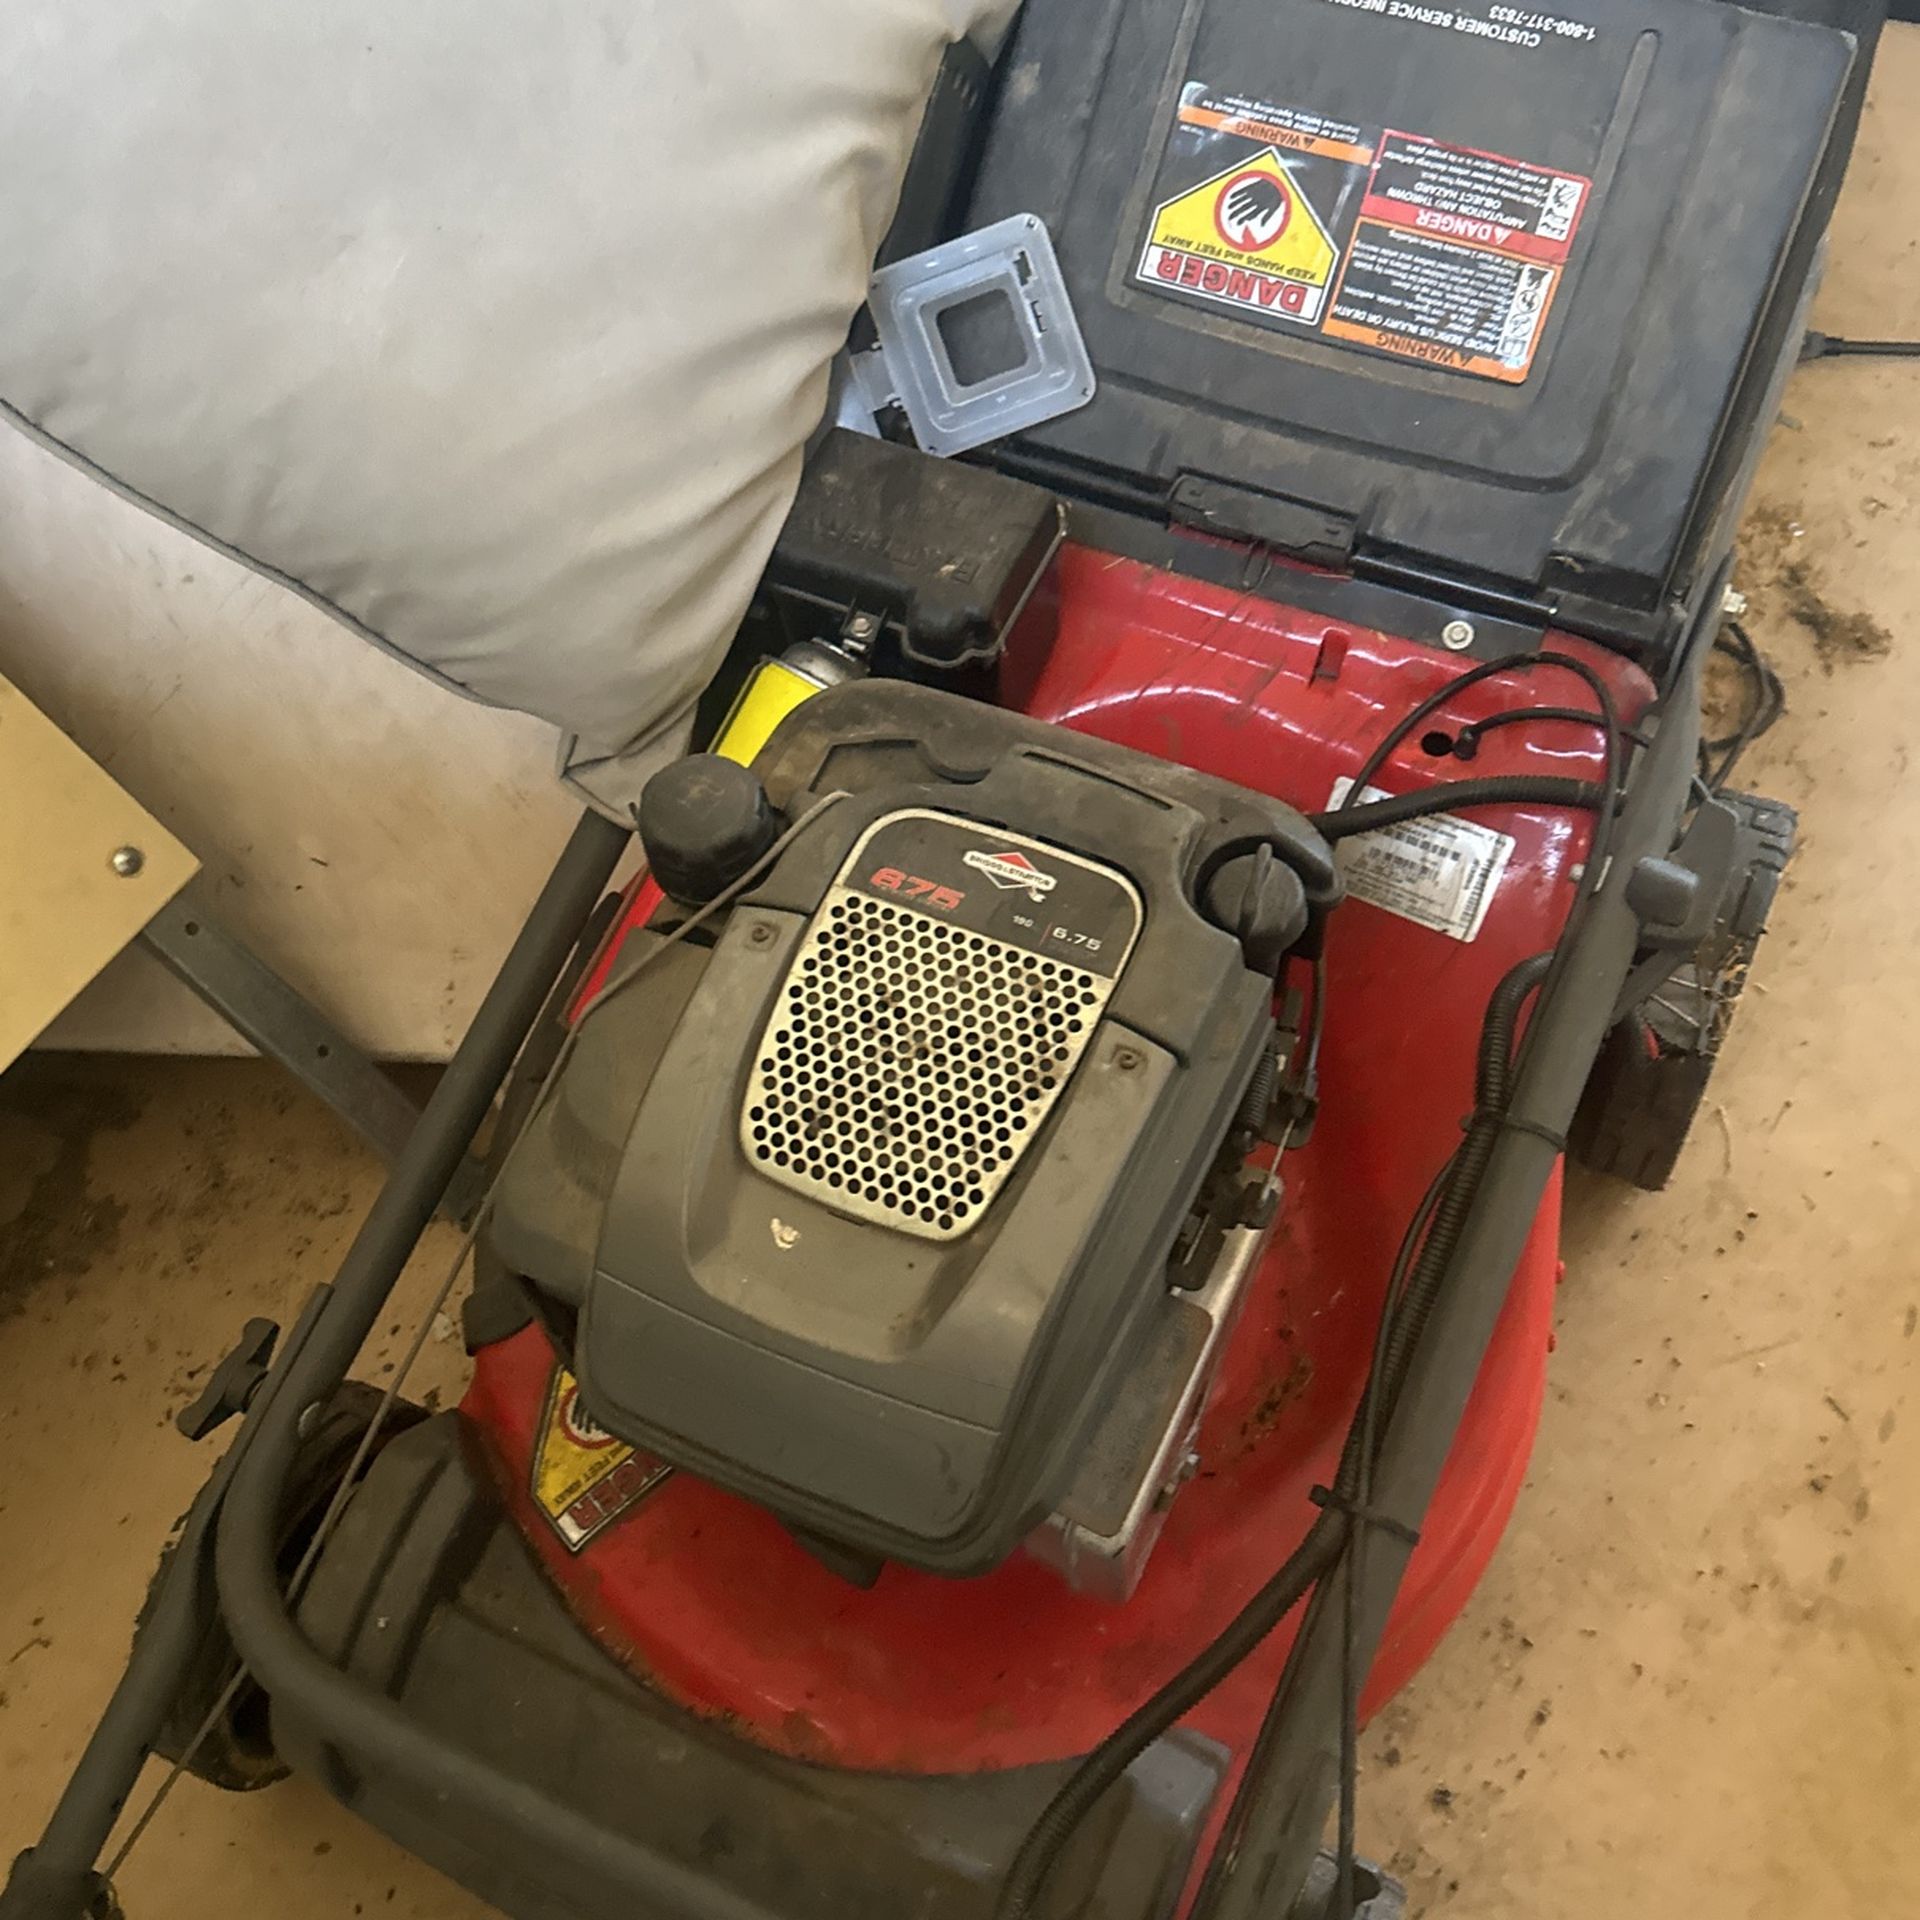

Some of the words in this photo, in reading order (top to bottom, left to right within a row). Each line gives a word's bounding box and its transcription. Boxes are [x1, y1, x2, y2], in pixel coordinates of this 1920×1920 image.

[1387, 1, 1452, 28] SERVICE
[1489, 4, 1597, 42] 1-800-317-7833
[1453, 17, 1541, 48] CUSTOMER
[1233, 120, 1301, 147] WARNING
[1385, 185, 1434, 206] THROWN
[1412, 180, 1458, 200] HAZARD
[1457, 190, 1502, 210] OBJECT
[1433, 198, 1458, 211] AND
[1415, 208, 1493, 240] DANGER
[1456, 202, 1528, 229] AMPUTATION
[1161, 233, 1193, 249] AWAY
[1194, 242, 1223, 256] FEET
[1222, 249, 1244, 262] and
[1244, 255, 1285, 273] HANDS
[1154, 250, 1308, 314] DANGER
[1285, 265, 1316, 281] KEEP
[1332, 303, 1367, 321] DEATH
[1365, 311, 1383, 325] OR
[1381, 315, 1420, 334] INJURY
[1373, 332, 1455, 363] WARNING
[1462, 336, 1496, 353] AVOID
[868, 865, 967, 909] 675
[1051, 925, 1103, 951] 6.75
